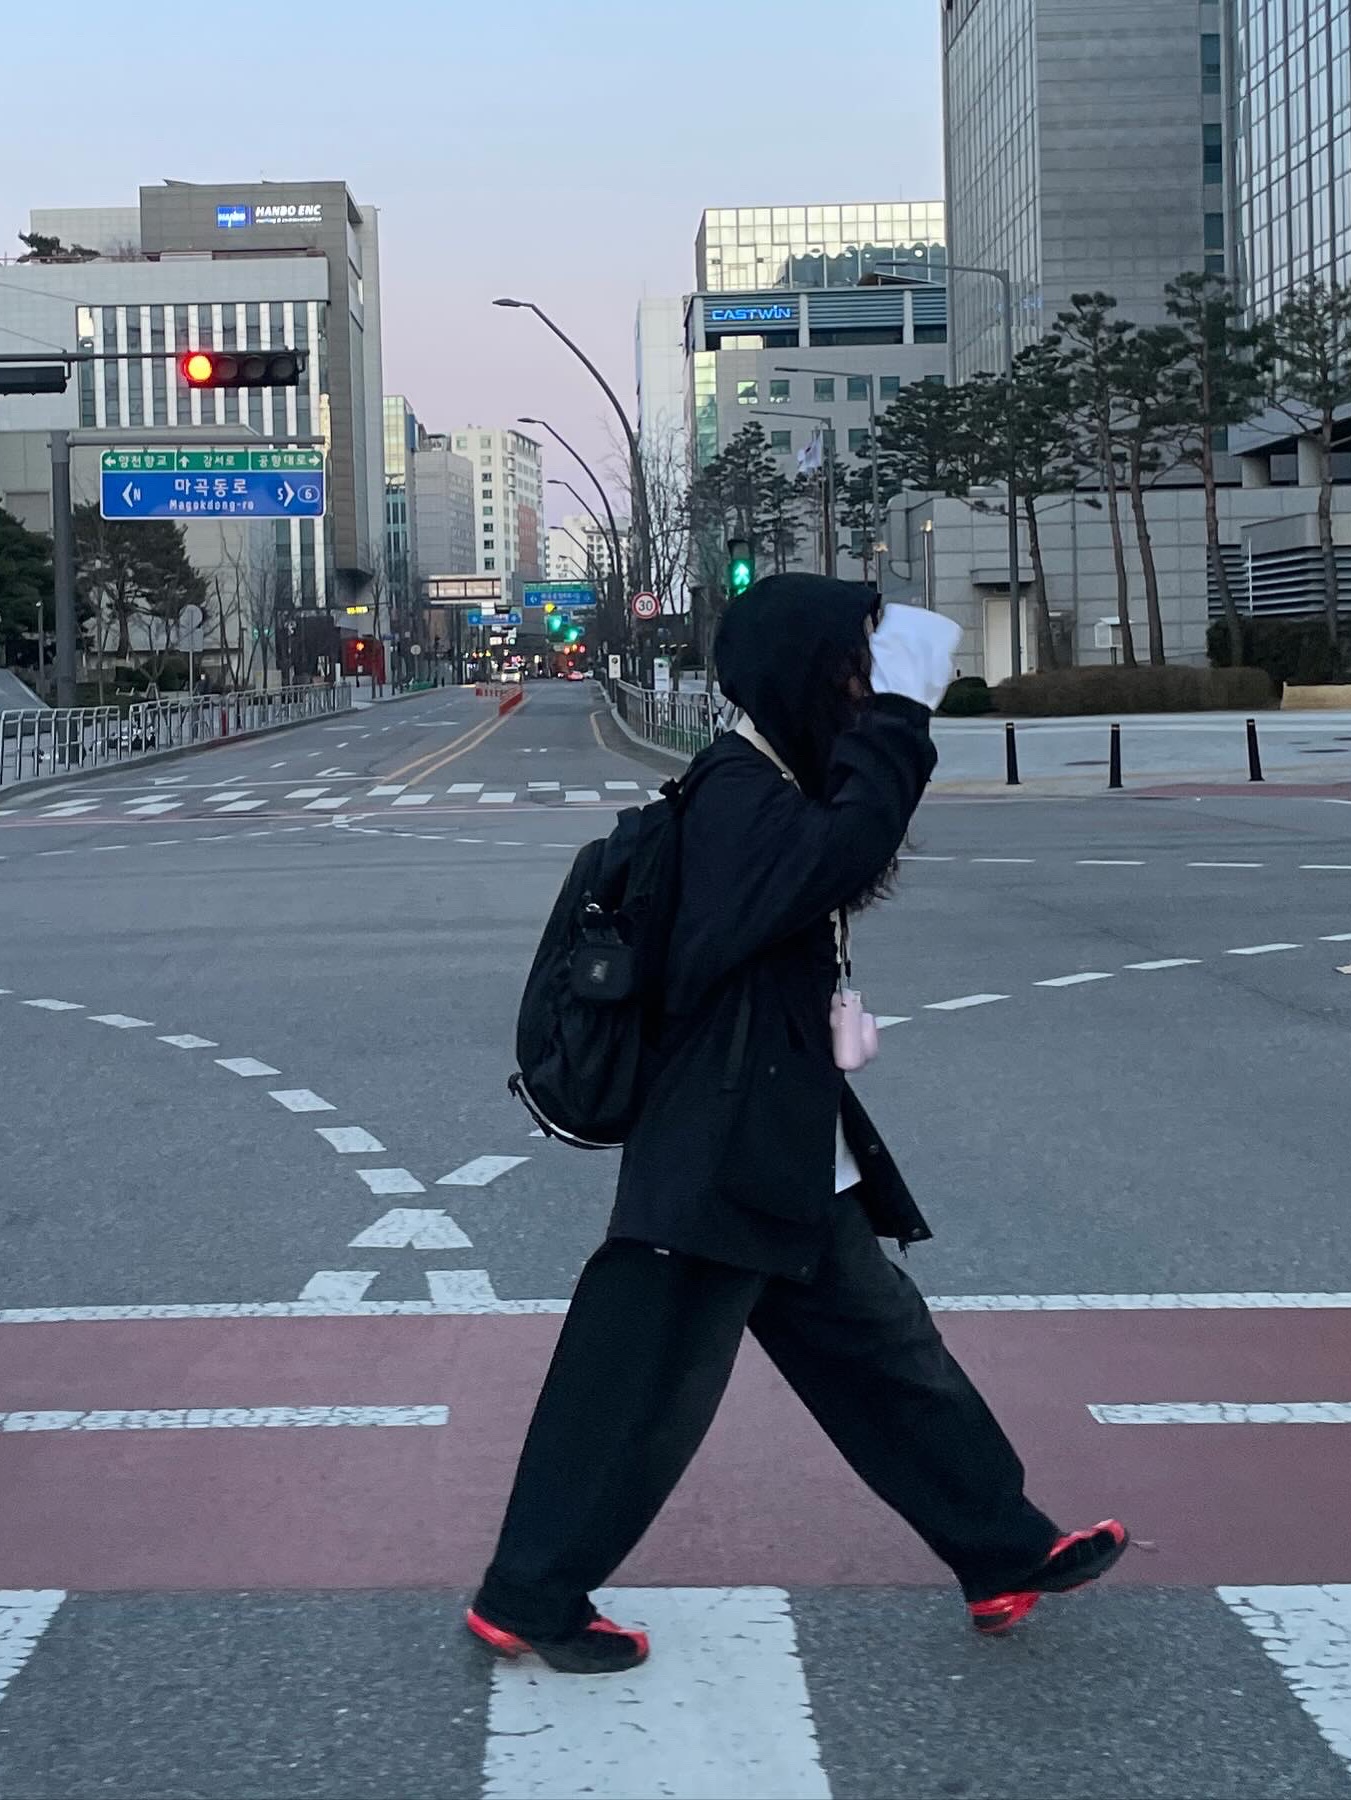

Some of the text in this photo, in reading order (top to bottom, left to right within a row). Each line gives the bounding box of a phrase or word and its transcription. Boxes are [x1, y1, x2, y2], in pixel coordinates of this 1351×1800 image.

[255, 204, 322, 217] HANBO ENC
[118, 455, 168, 469] 양천향교
[203, 454, 235, 468] 강서로
[258, 454, 307, 468] 공항대로
[133, 487, 141, 501] N
[174, 478, 248, 497] 마곡동로
[277, 487, 284, 501] S
[169, 499, 254, 512] Magokdong-ro
[638, 600, 653, 611] 30
